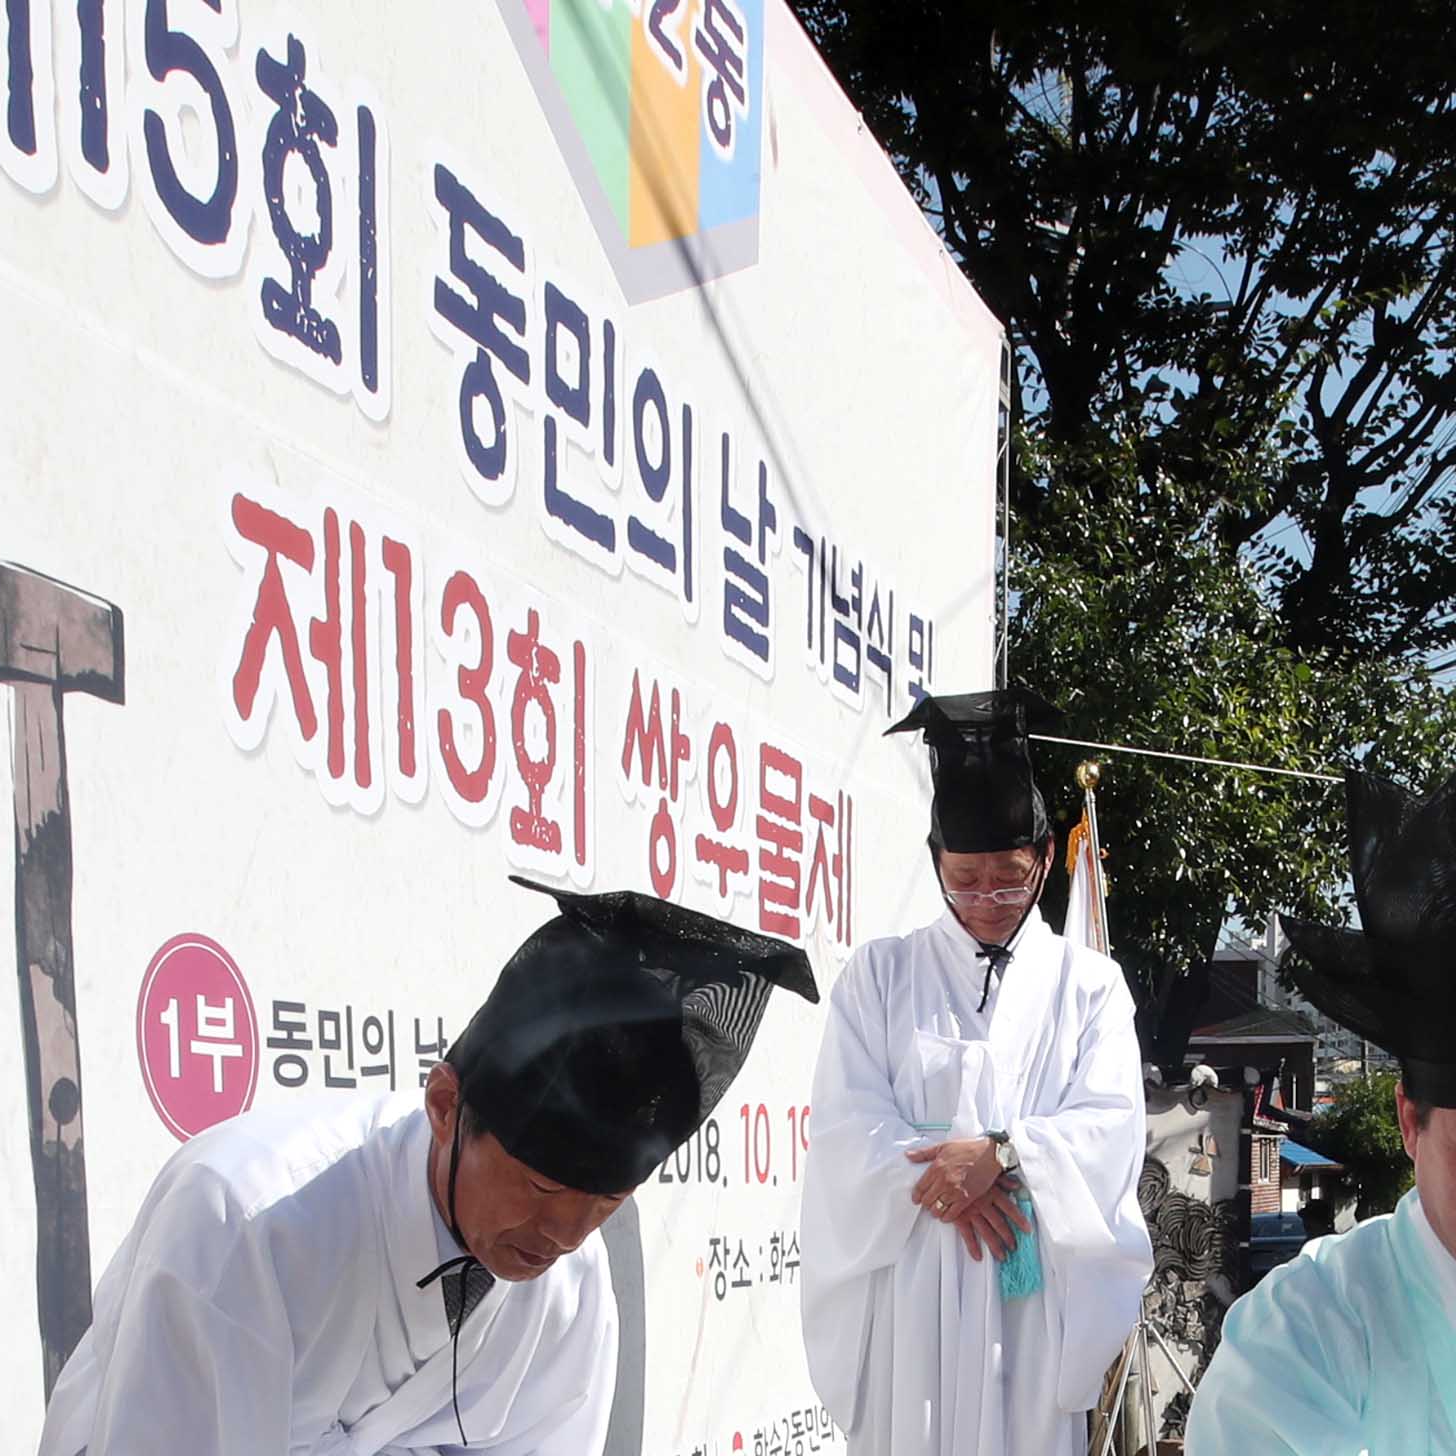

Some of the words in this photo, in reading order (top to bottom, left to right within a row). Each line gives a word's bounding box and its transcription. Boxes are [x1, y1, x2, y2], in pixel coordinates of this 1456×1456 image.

[434, 163, 693, 603] 동민의
[721, 431, 777, 664] 날
[793, 525, 894, 718] 기념식
[907, 612, 934, 711] 및
[231, 491, 586, 867] 제13회
[621, 667, 853, 948] 쌍우물제
[159, 994, 244, 1094] 1부
[266, 1000, 396, 1093] 동민의
[740, 1103, 777, 1187] 10.
[769, 1231, 801, 1285] 화수
